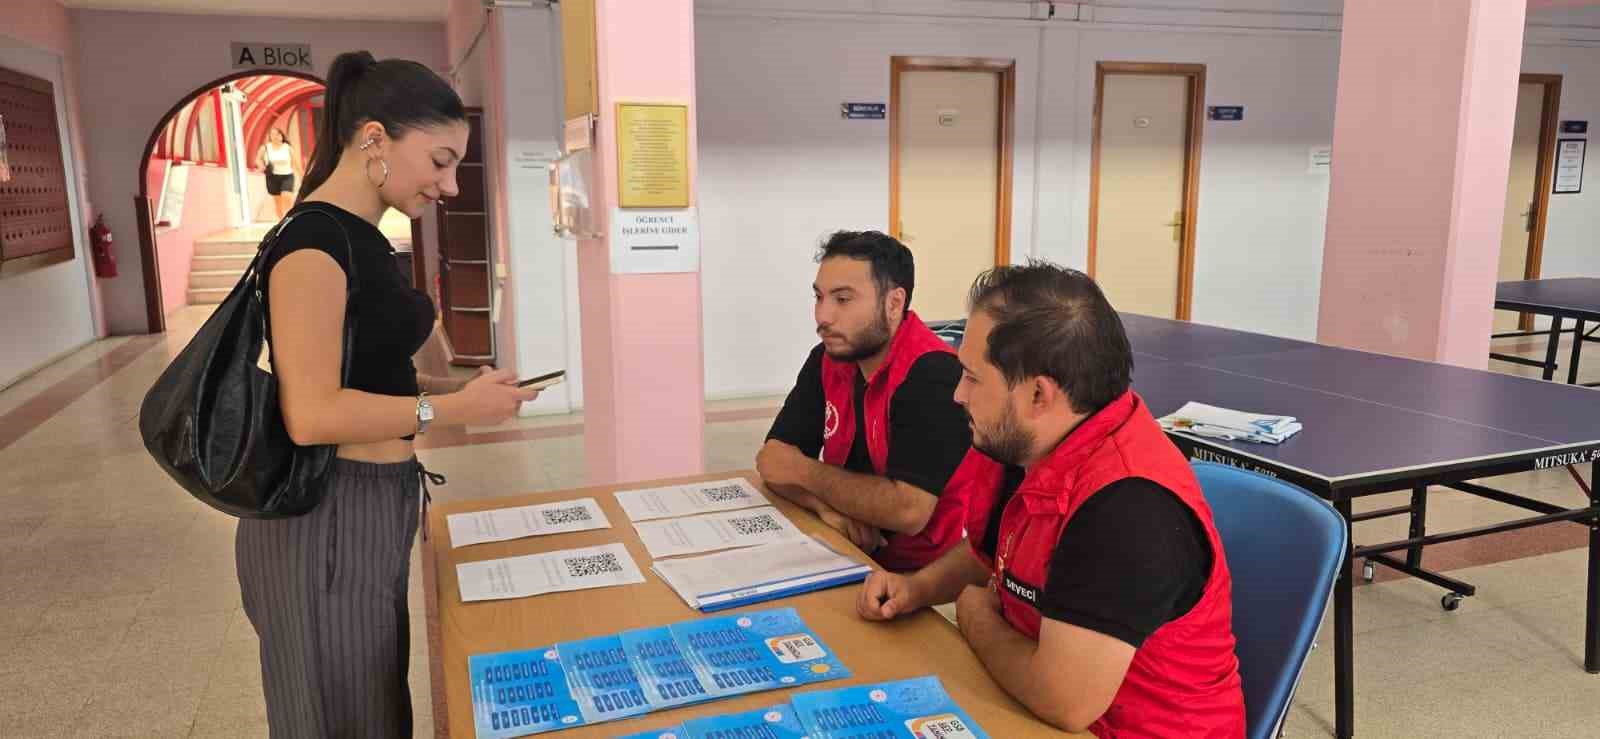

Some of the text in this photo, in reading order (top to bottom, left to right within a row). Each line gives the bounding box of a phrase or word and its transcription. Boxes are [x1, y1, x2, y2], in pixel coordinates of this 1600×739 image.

[239, 47, 310, 66] A Blok
[1535, 451, 1585, 469] MITSUKA
